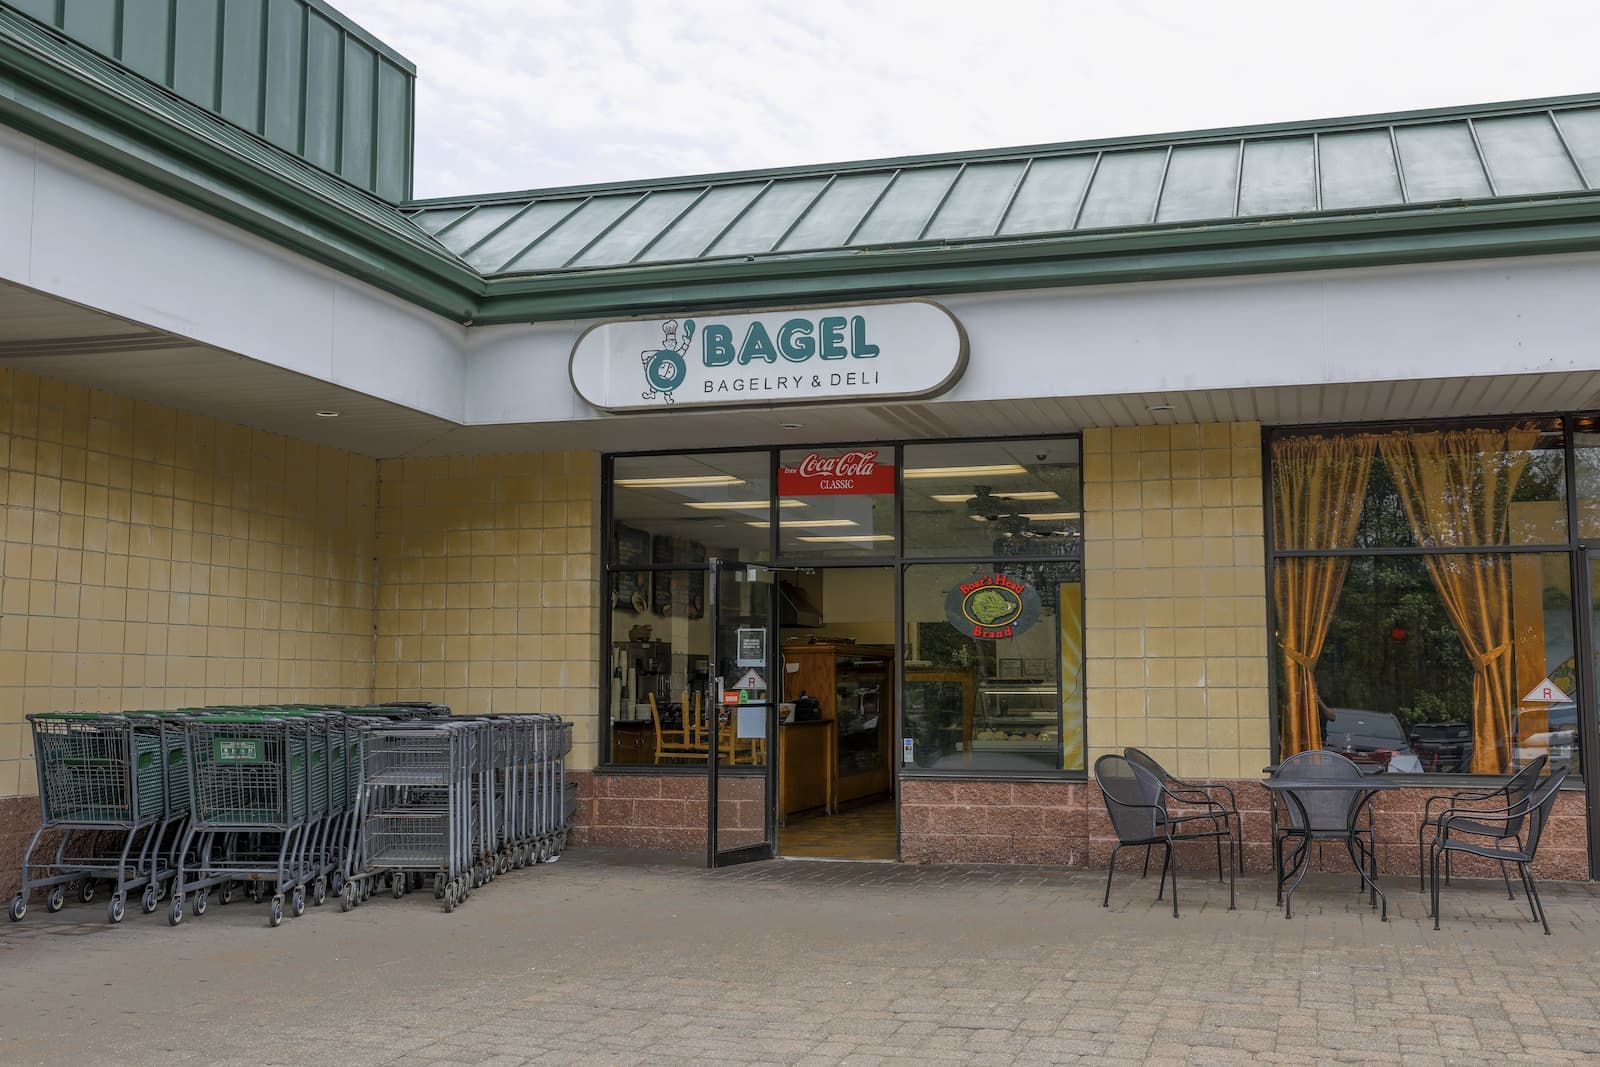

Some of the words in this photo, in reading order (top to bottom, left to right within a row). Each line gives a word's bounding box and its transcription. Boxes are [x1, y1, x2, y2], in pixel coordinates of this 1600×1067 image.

[703, 315, 880, 367] BAGEL
[704, 376, 803, 393] BAGELRY
[811, 375, 822, 388] &
[830, 371, 879, 386] DELI
[819, 479, 854, 490] CLASSIC
[960, 575, 993, 595] Boar's
[995, 574, 1025, 594] Head
[973, 625, 1013, 639] Brand
[748, 677, 756, 687] R
[1543, 688, 1552, 699] R
